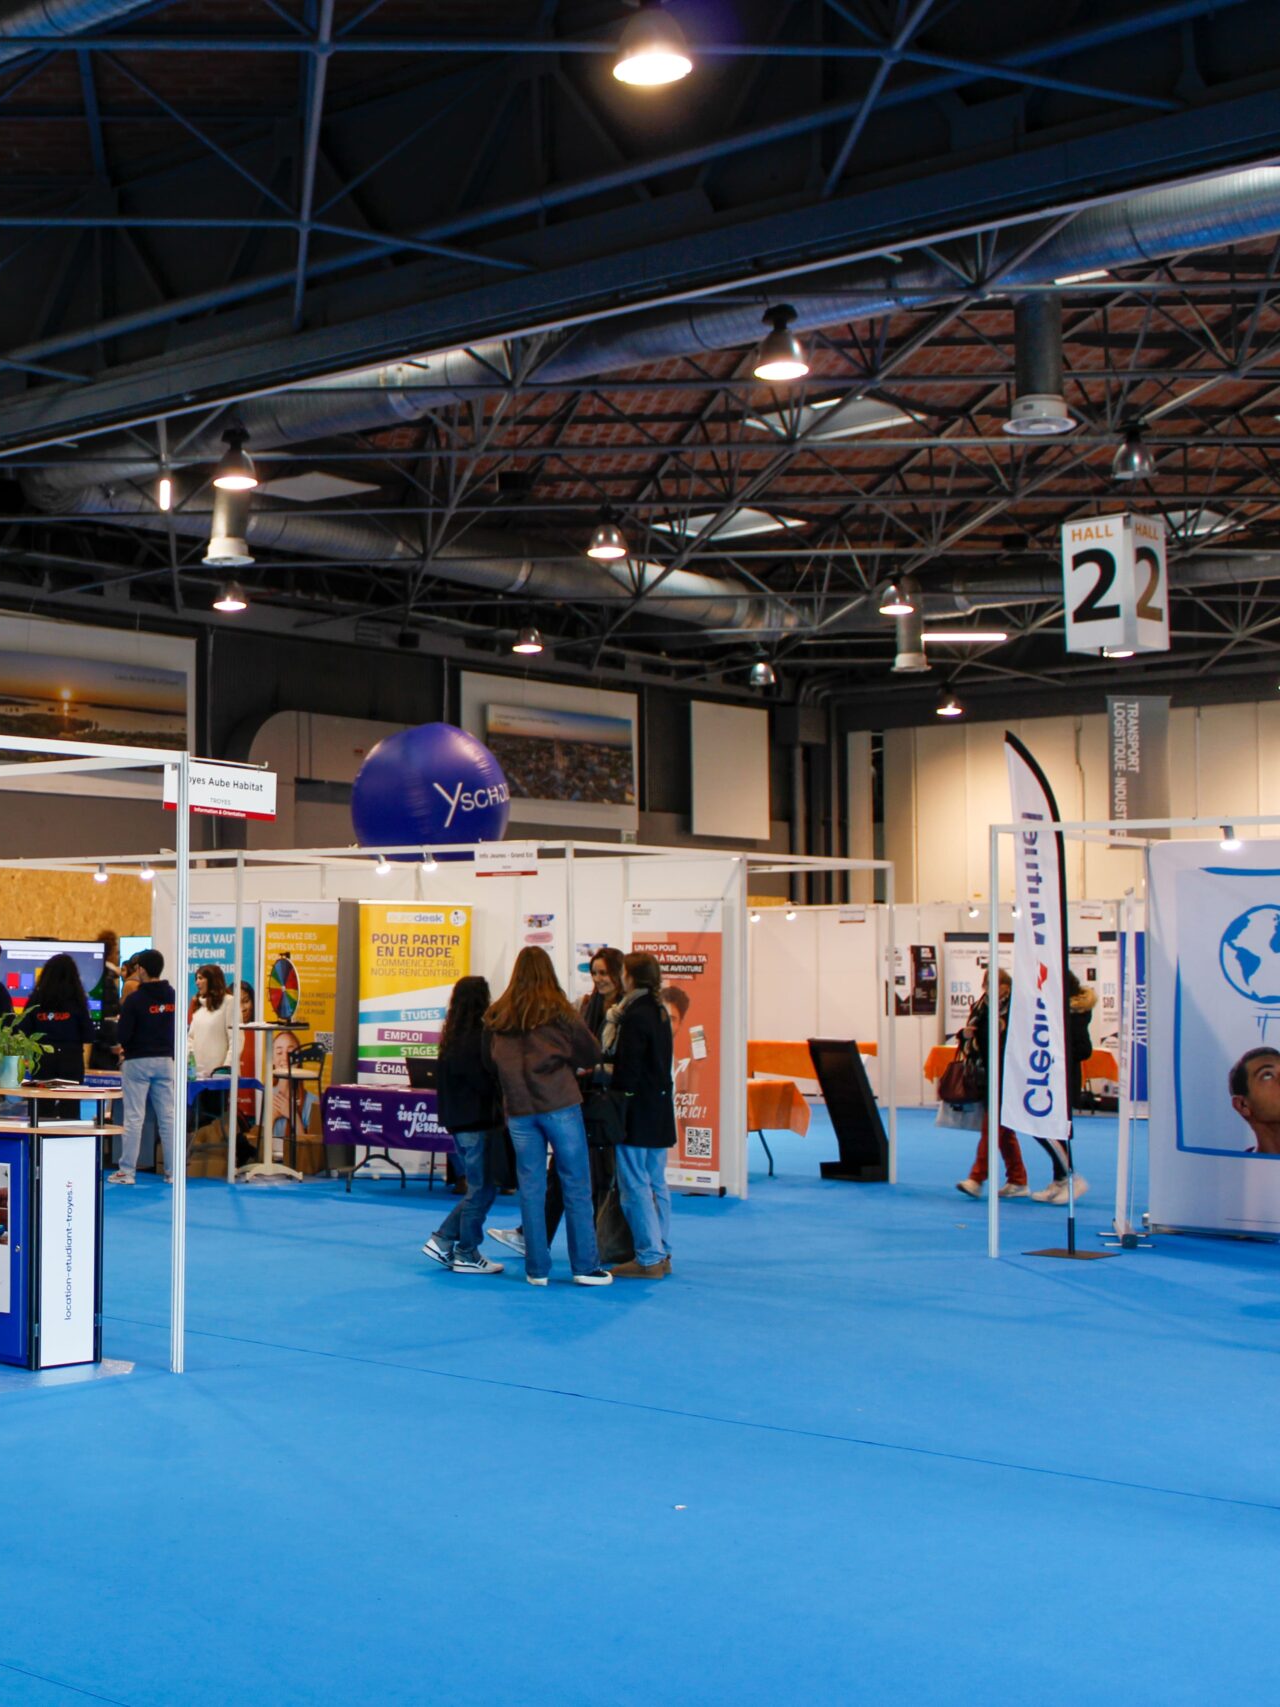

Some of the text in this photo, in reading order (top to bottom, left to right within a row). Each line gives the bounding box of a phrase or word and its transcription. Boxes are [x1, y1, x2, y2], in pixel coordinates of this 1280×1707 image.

[1071, 524, 1114, 542] HALL
[1135, 522, 1158, 541] HALL
[1073, 548, 1120, 623] 2
[1135, 546, 1163, 622] 2
[1113, 702, 1127, 771] LOGISTIQUE
[1128, 702, 1140, 774] TRANSPORT
[189, 776, 263, 792] yes Aube Habitat
[1114, 777, 1128, 837] INDUSTE
[189, 933, 210, 943] IEUX
[371, 933, 460, 945] POUR PARTIR
[188, 947, 226, 958] RÉVENIR
[377, 946, 394, 957] EN
[376, 959, 434, 967] COMMENCEZ
[371, 967, 460, 977] NOUS RENCONTRER
[950, 982, 971, 992] BTS
[400, 1008, 440, 1020] ÉTUDES
[384, 1030, 423, 1042] EMPLOI
[400, 1046, 439, 1056] STAGES
[375, 1062, 409, 1075] ÉCHAN
[675, 1106, 687, 1119] AR
[64, 1180, 74, 1321] location-etudiant-troyes.fr
